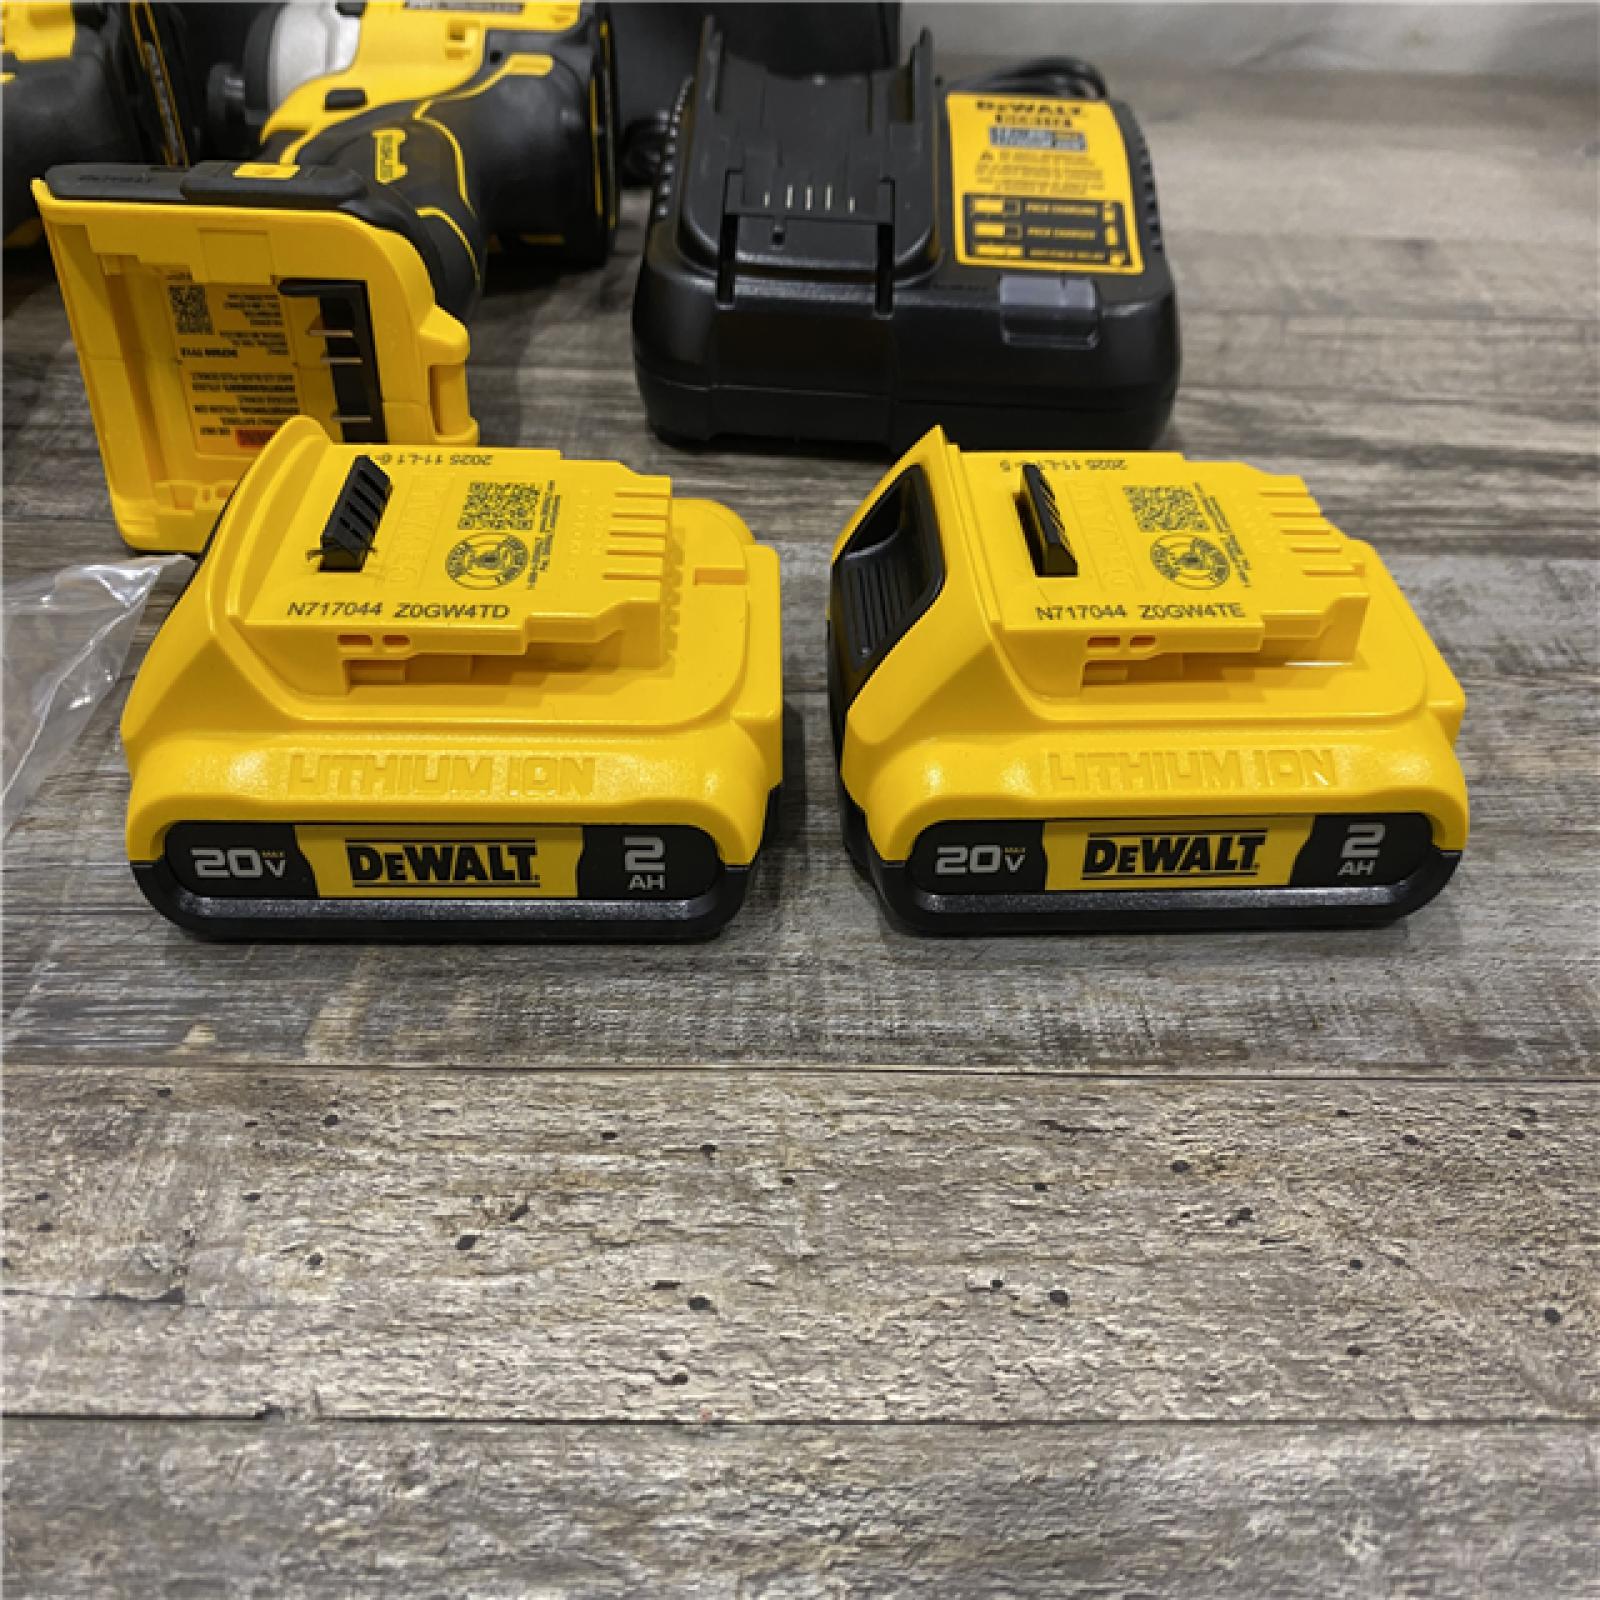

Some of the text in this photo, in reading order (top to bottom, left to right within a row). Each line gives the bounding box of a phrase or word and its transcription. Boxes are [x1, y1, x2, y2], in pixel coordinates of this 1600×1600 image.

[287, 601, 383, 616] N717044
[1035, 604, 1128, 620] N717044
[288, 754, 596, 796] LITHIUM ION
[1048, 750, 1336, 790] LITHIUM ION
[623, 836, 666, 872] 2
[1340, 824, 1386, 858] 2
